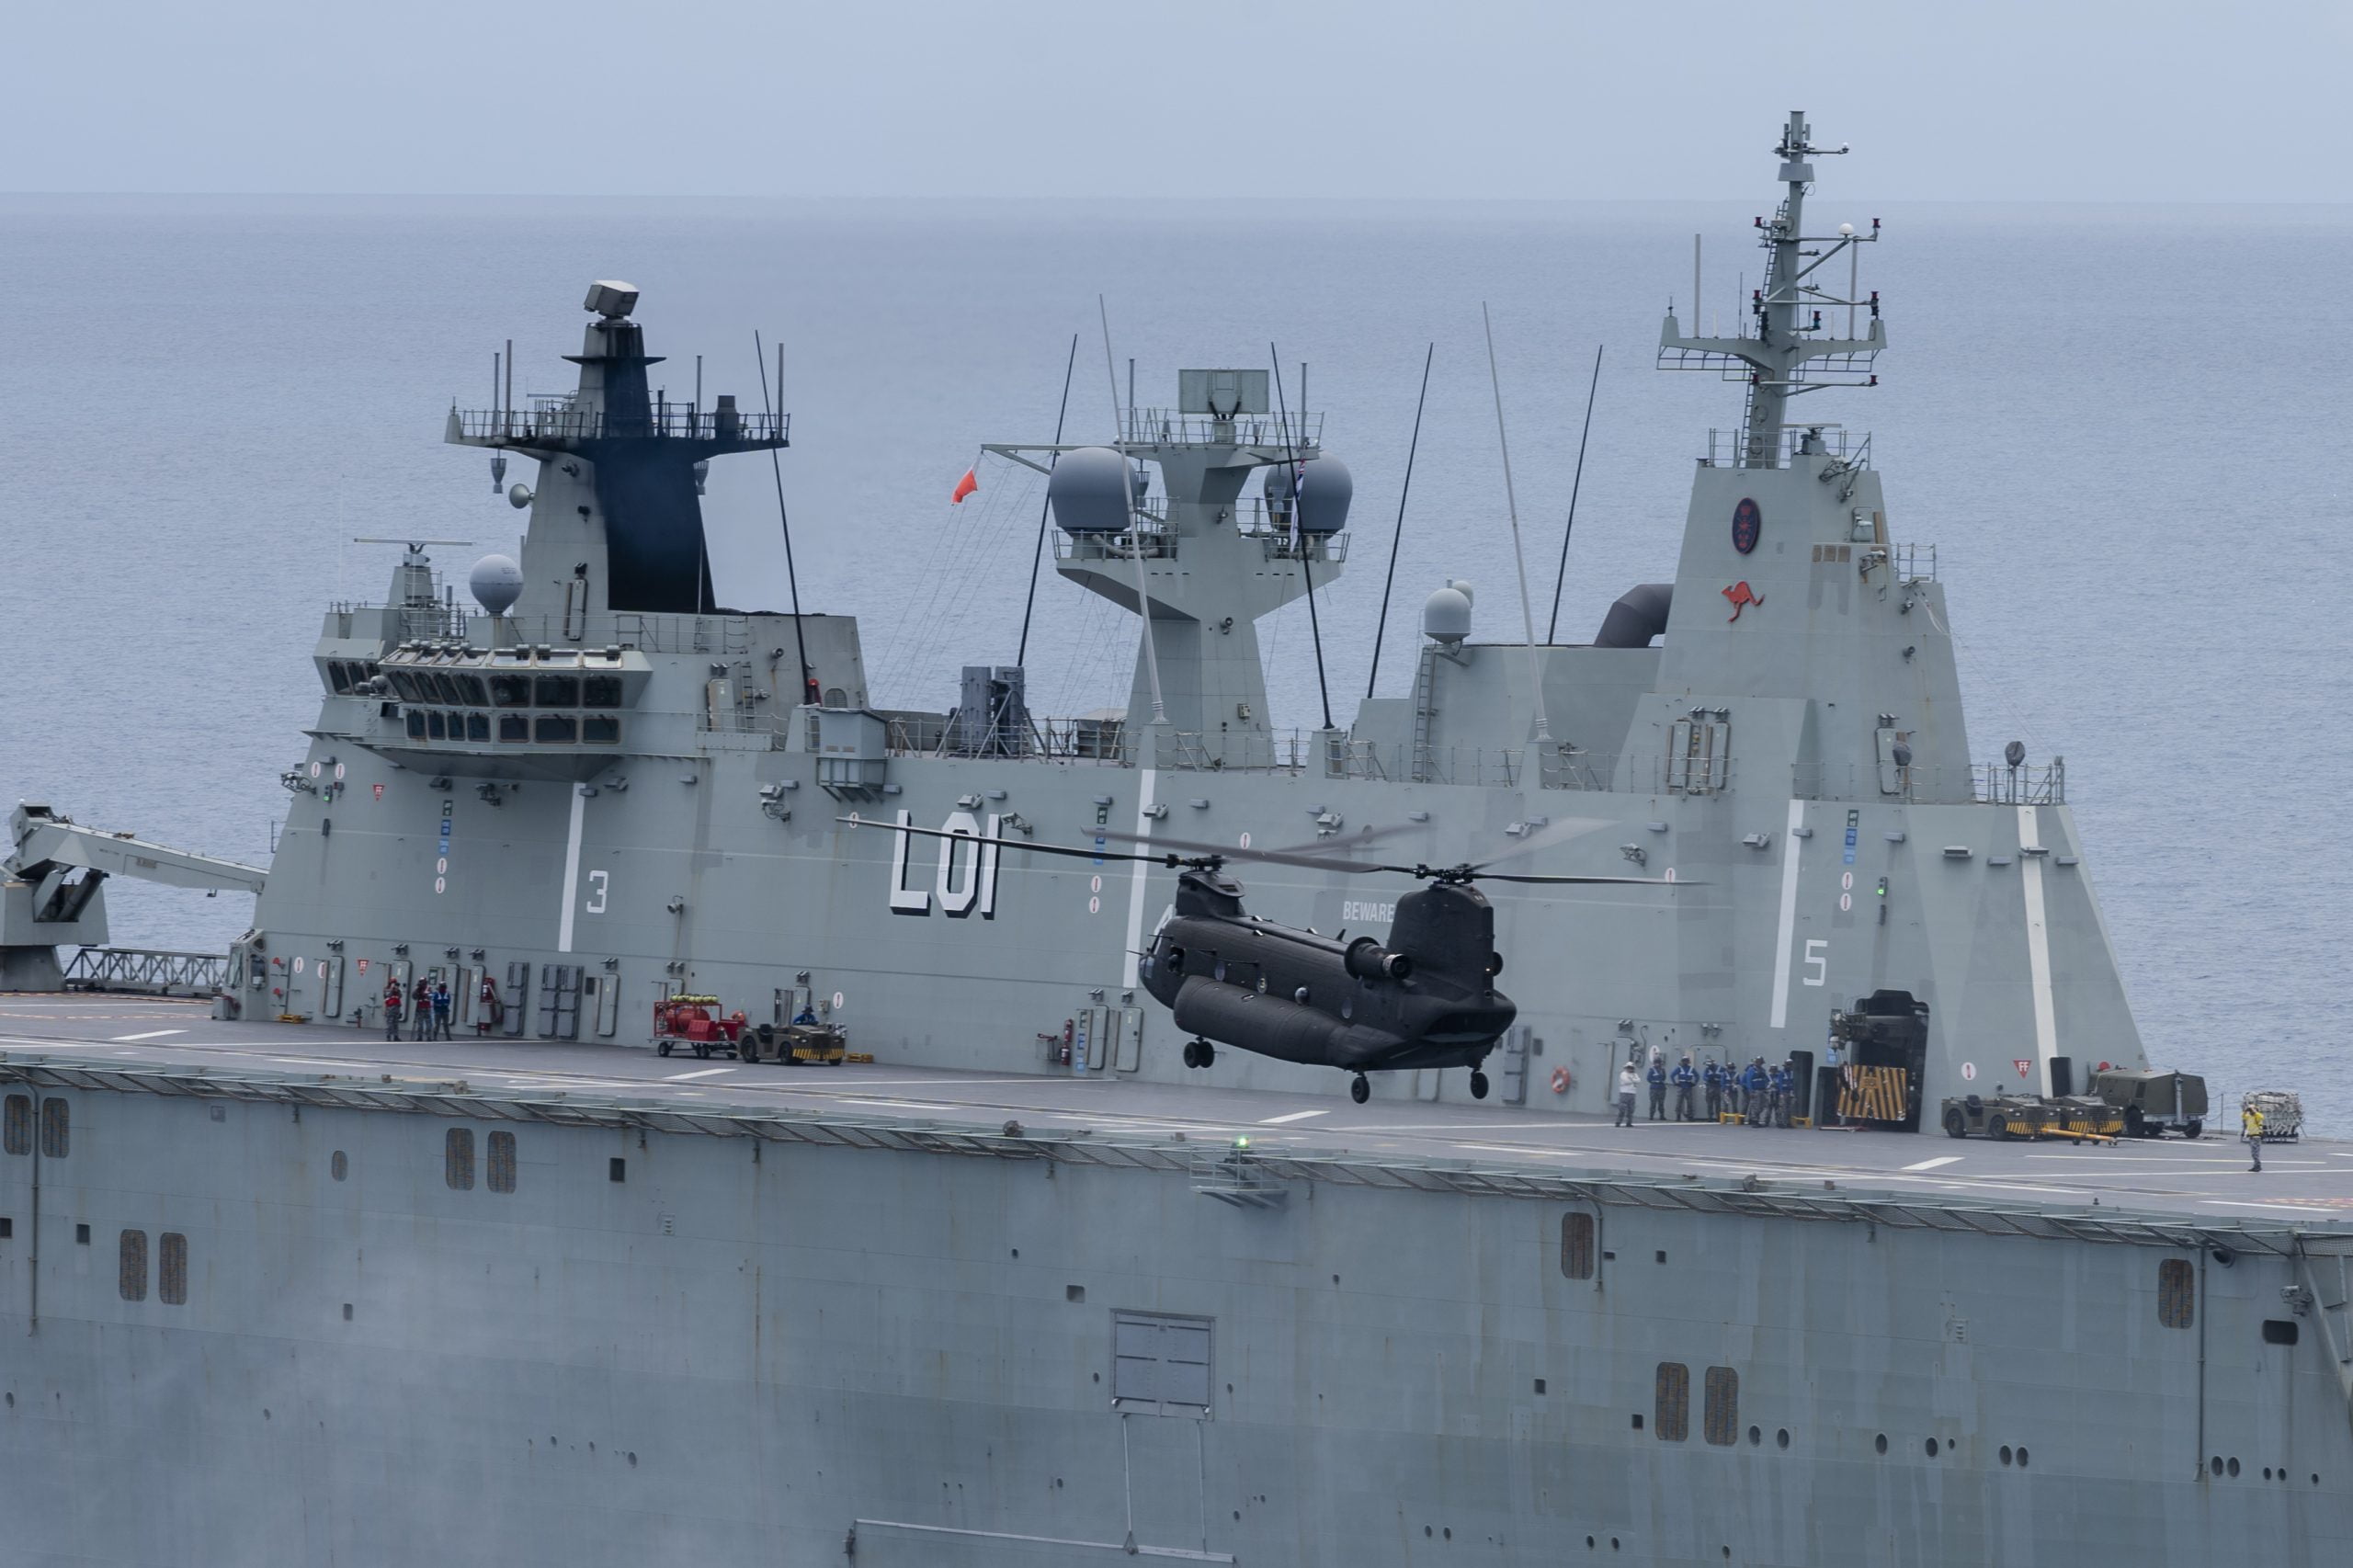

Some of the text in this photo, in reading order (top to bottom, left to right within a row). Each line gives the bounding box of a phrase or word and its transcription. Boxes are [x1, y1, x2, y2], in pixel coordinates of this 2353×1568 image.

[586, 869, 608, 914] 3
[1343, 901, 1396, 923] BEWARE
[1802, 939, 1828, 986] 5
